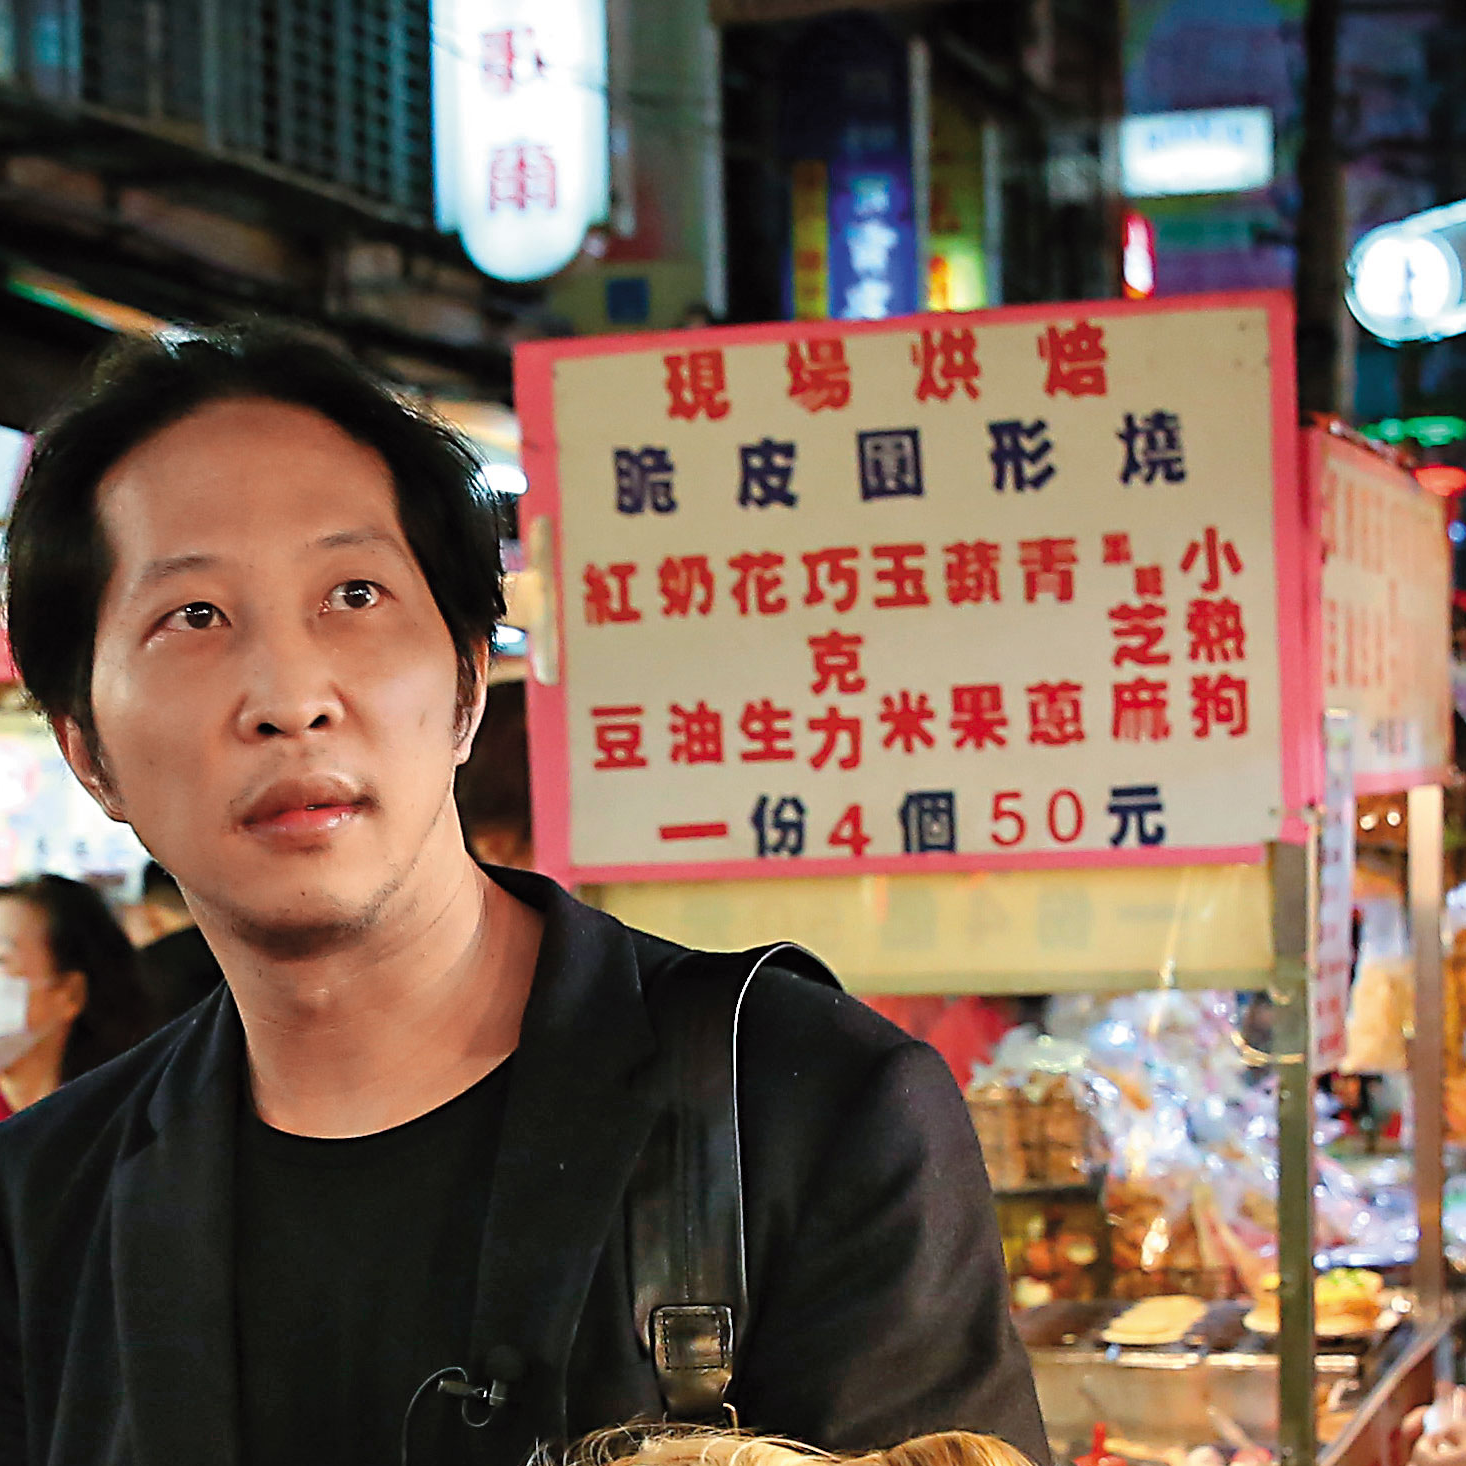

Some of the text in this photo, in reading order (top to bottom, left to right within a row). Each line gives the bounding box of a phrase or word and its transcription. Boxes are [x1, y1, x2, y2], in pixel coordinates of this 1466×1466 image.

[663, 320, 1108, 421] 現場烘焙
[612, 410, 1188, 515] 脆皮圓形燒
